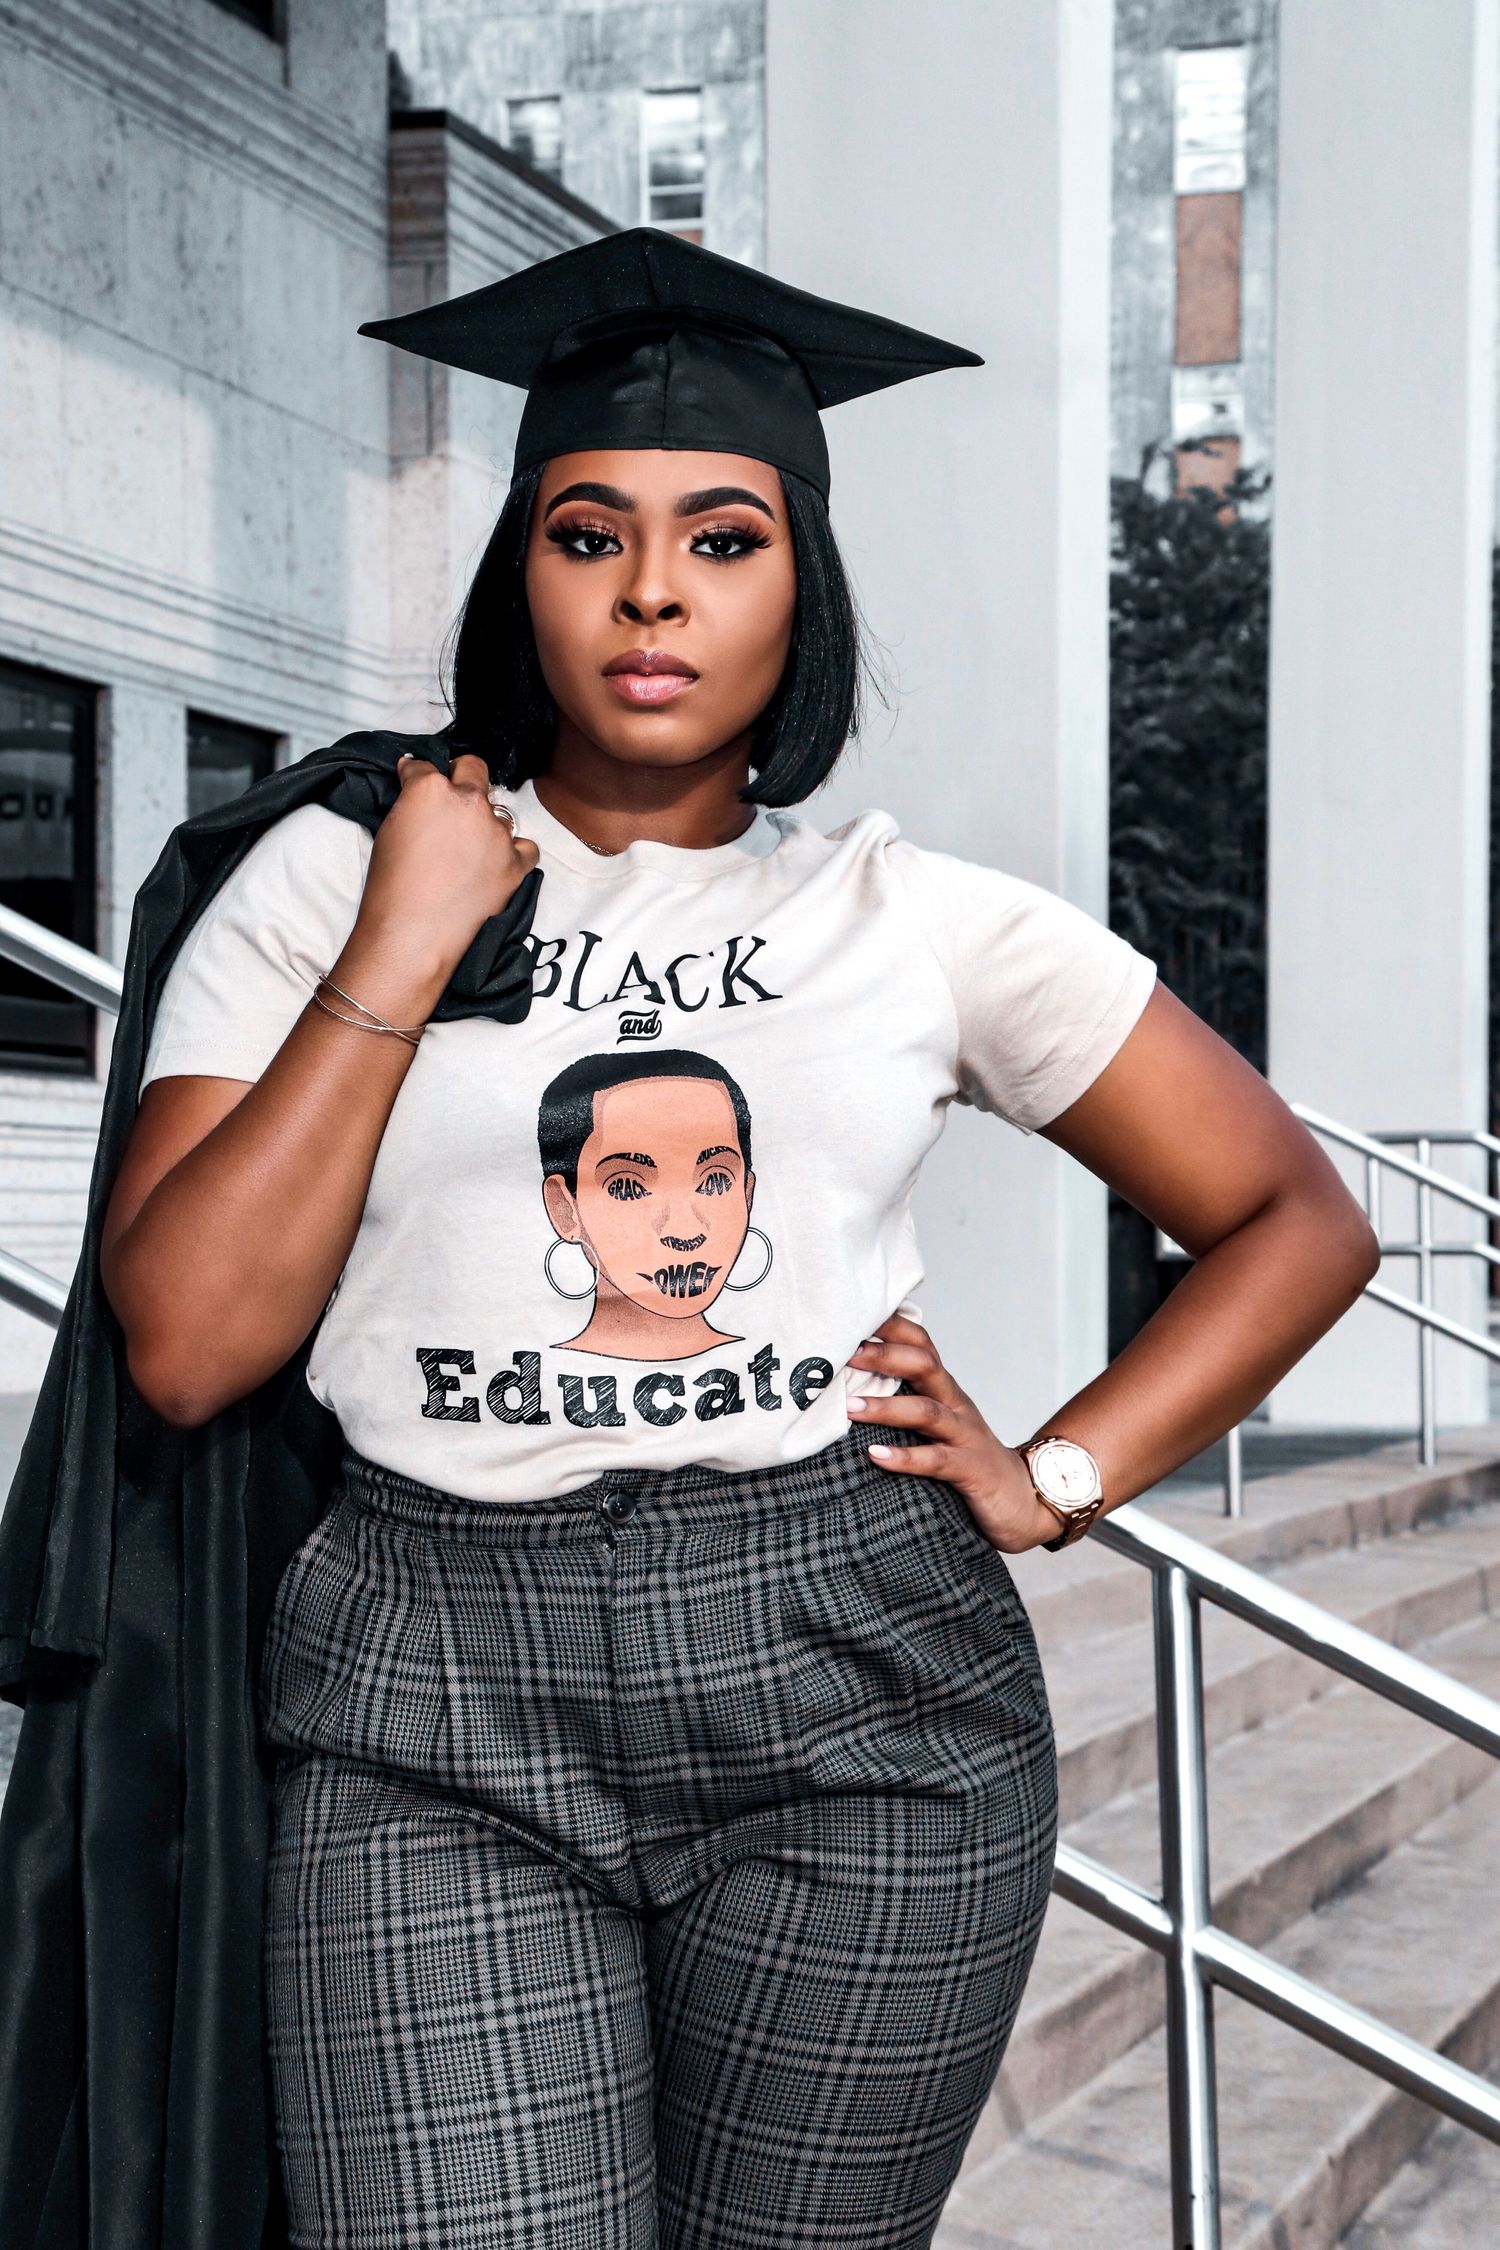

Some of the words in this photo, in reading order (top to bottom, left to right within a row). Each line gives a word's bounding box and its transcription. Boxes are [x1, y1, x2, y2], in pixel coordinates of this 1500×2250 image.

[528, 931, 783, 1012] BLACK
[617, 1009, 662, 1042] and
[607, 1177, 653, 1201] GRACE
[695, 1172, 732, 1196] LOVE
[416, 1343, 834, 1427] Educate
